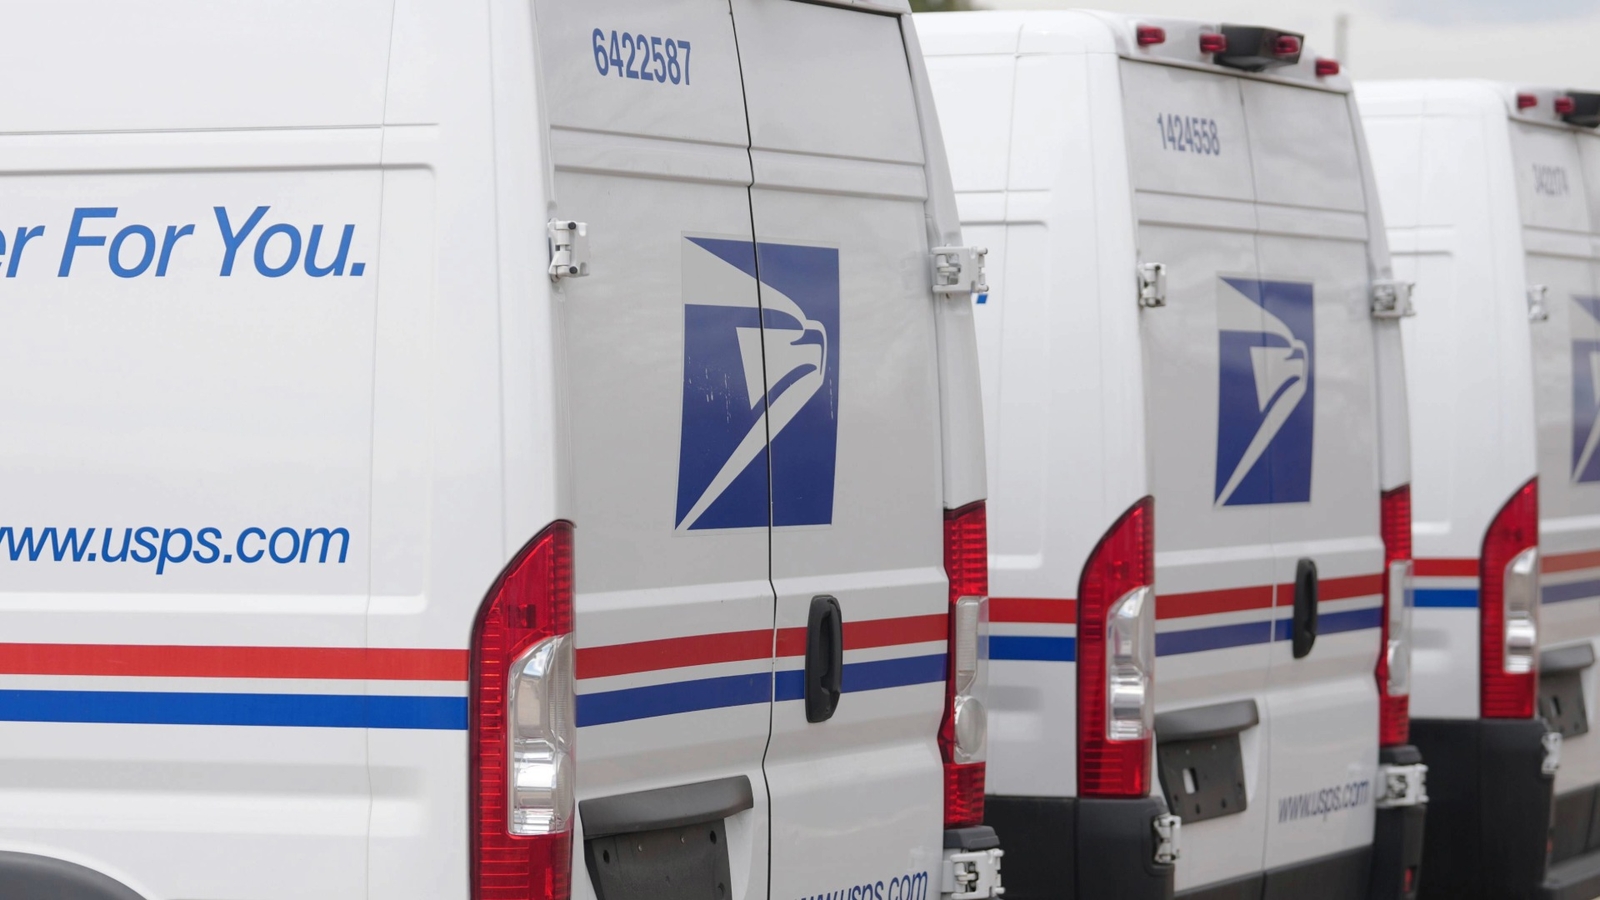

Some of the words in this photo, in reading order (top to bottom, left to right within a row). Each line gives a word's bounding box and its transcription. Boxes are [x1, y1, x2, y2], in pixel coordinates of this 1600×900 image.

[592, 28, 691, 86] 6422587
[1157, 112, 1220, 156] 1424558
[57, 206, 194, 279] For
[213, 206, 366, 279] You.
[0, 526, 350, 576] ww.usps.com
[1278, 780, 1369, 822] www.usps.com
